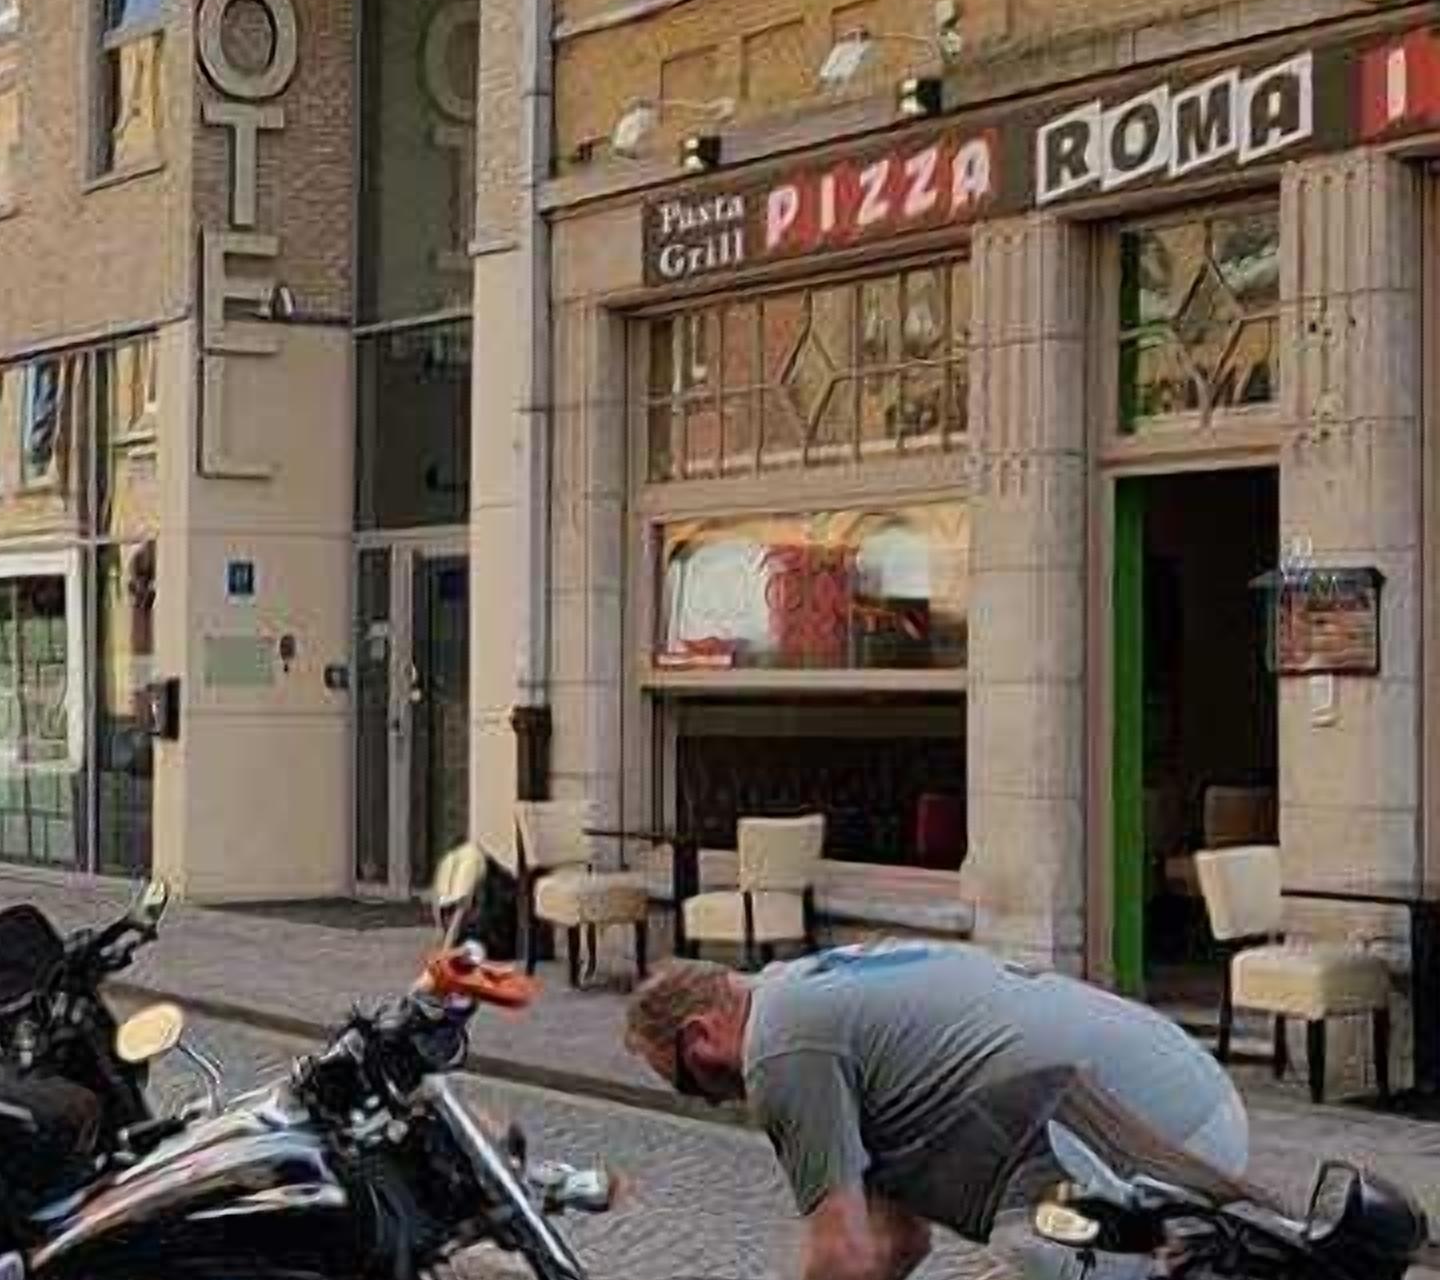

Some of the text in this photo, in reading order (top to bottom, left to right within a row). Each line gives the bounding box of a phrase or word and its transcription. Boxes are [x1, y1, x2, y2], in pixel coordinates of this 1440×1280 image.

[764, 138, 993, 250] PIZZA
[1042, 65, 1303, 194] ROMA
[659, 193, 745, 234] Pasta
[660, 227, 745, 277] Grill
